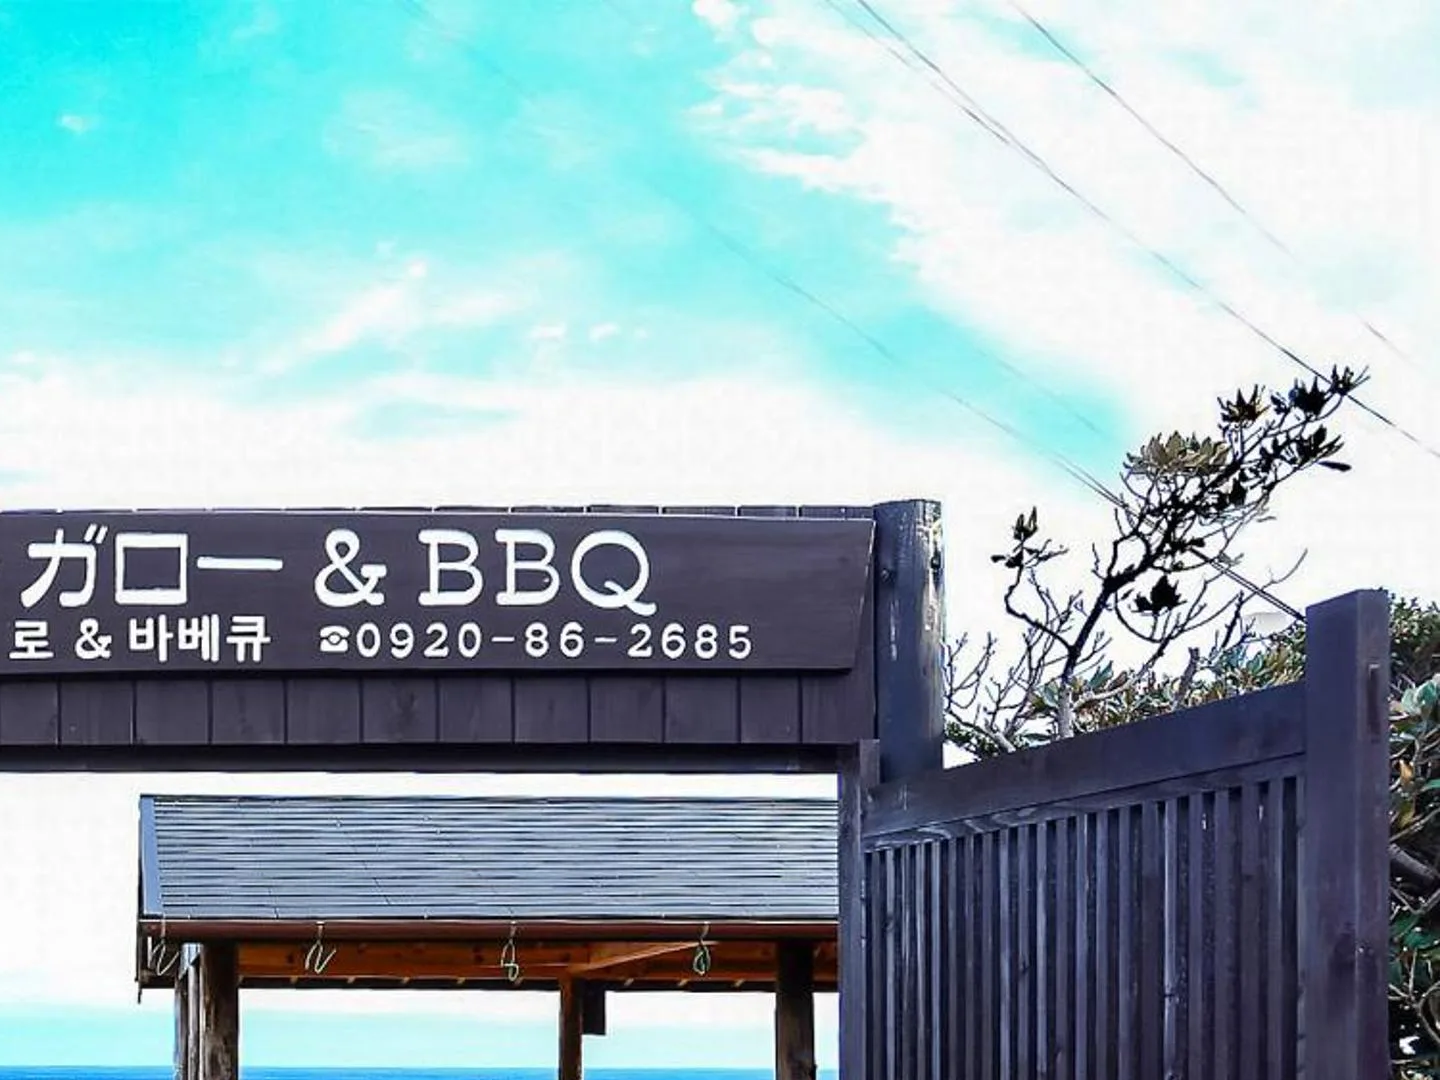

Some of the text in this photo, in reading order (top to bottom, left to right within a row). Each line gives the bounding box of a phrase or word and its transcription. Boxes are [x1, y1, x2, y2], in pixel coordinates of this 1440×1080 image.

[314, 528, 388, 607] &
[417, 528, 658, 617] BBQ
[355, 621, 752, 660] 0920-86-2685
